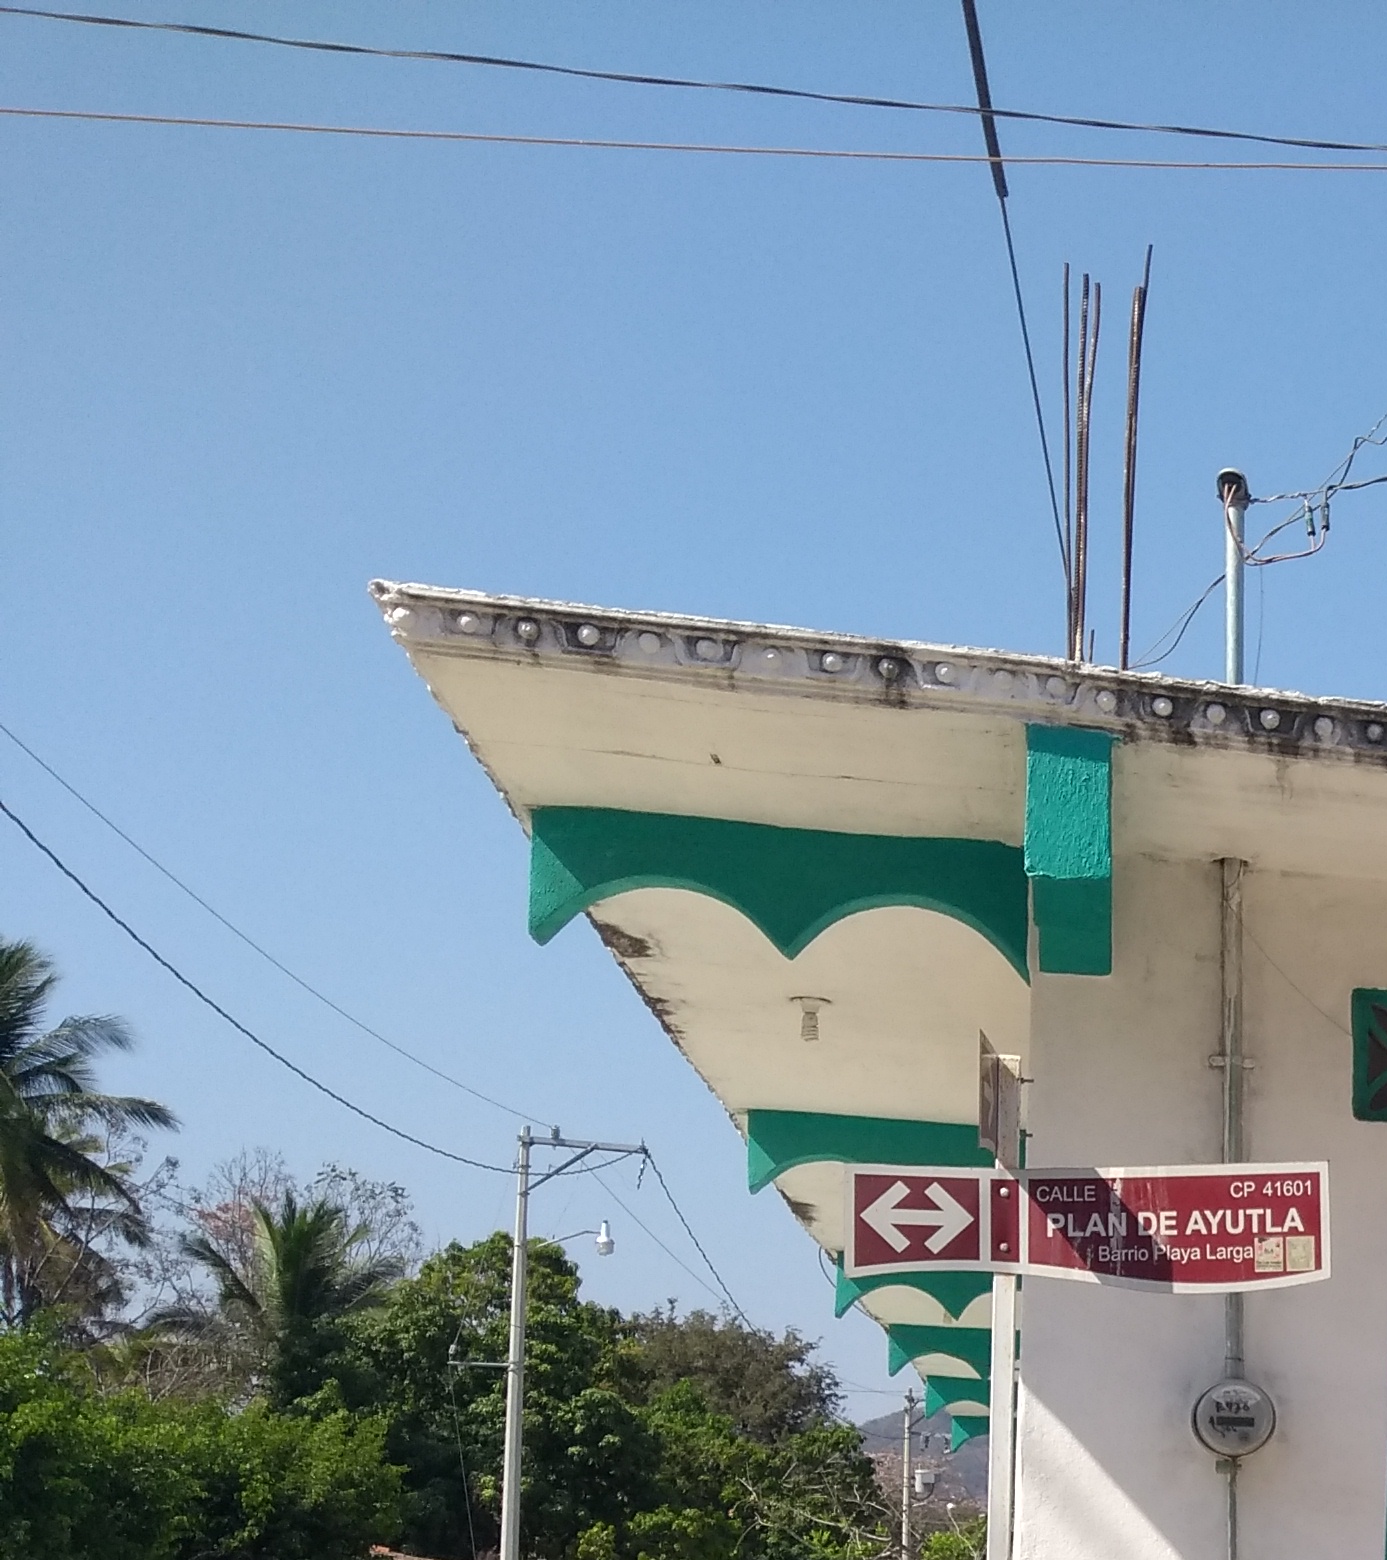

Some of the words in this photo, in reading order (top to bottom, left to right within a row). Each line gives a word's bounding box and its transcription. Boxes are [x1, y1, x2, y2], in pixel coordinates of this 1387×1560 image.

[1036, 1185, 1096, 1203] CALLE
[1230, 1182, 1256, 1198] CP
[1262, 1180, 1312, 1197] 41601
[1046, 1212, 1127, 1238] PLAN
[1137, 1210, 1178, 1237] DE
[1185, 1207, 1305, 1236] AYUTLA
[1098, 1245, 1149, 1262] Barrio
[1153, 1244, 1201, 1264] Playa
[1206, 1243, 1254, 1263] Larga
